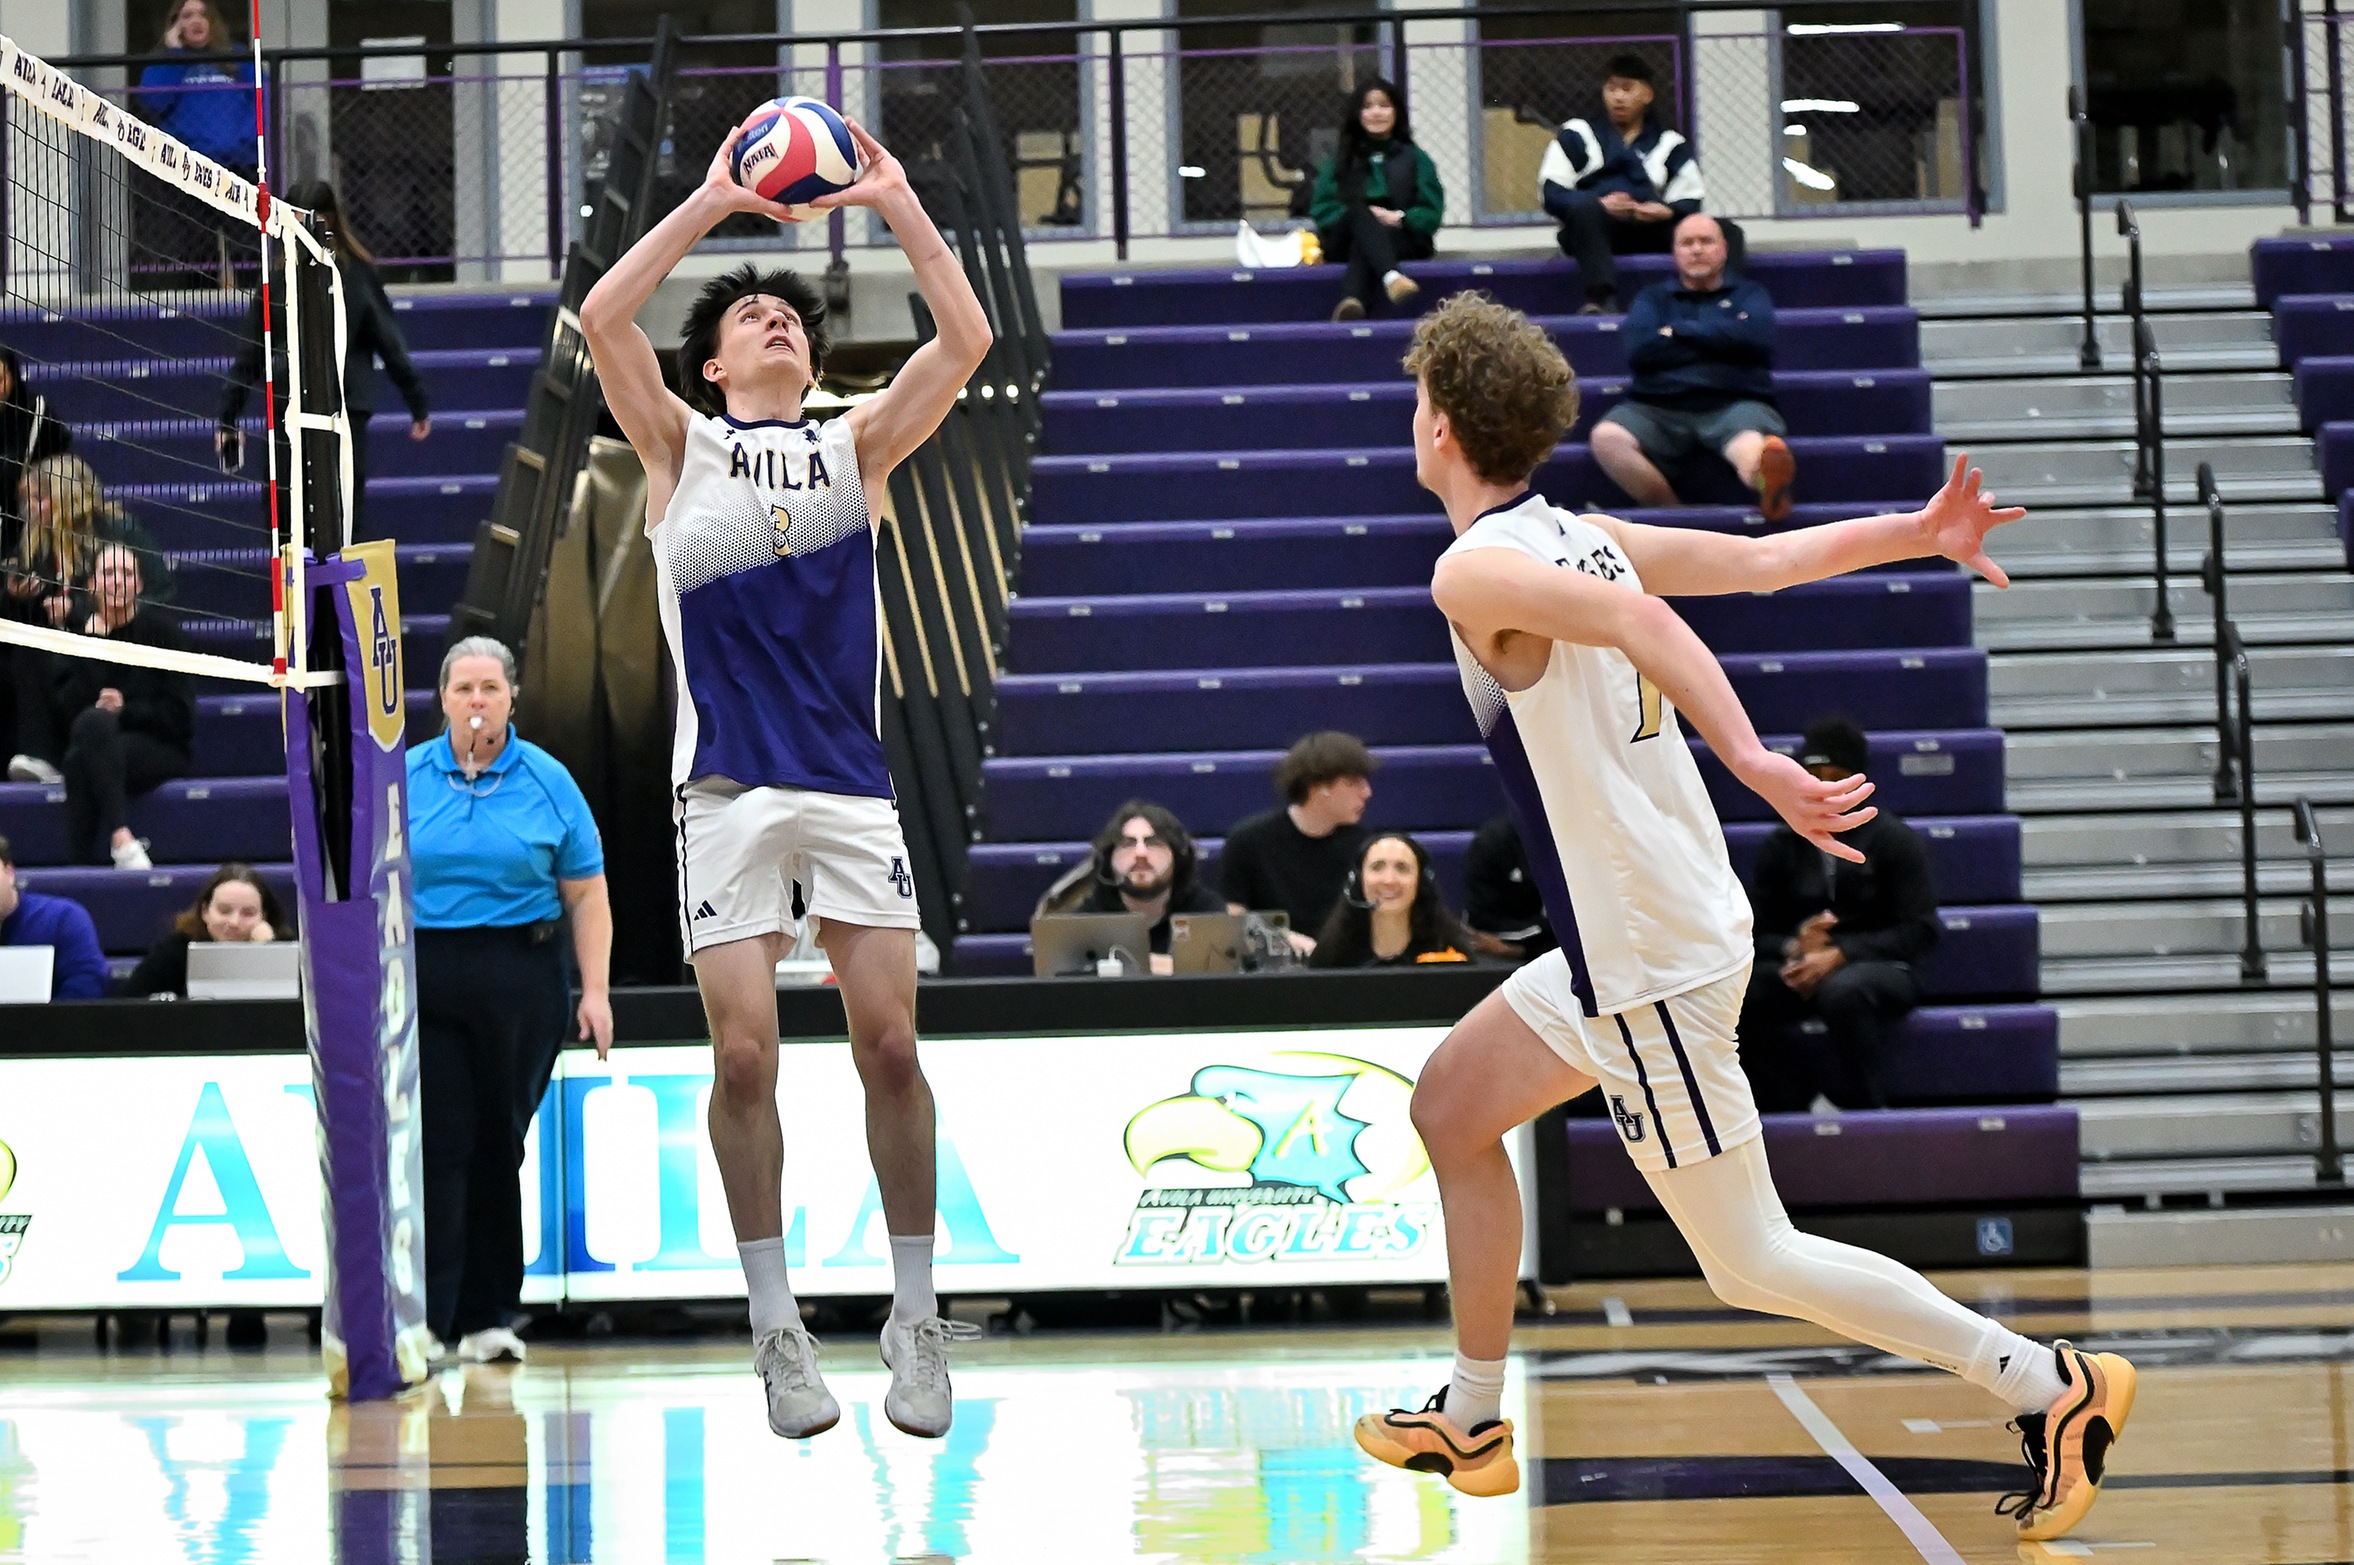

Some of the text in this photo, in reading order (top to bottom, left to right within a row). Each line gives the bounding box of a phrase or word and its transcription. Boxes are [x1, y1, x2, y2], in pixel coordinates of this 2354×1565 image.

[743, 145, 776, 176] NAIA
[889, 856, 912, 898] AU
[1610, 1095, 1646, 1143] AU
[116, 1074, 1020, 1283] AILA
[1116, 1204, 1437, 1264] EAGLES
